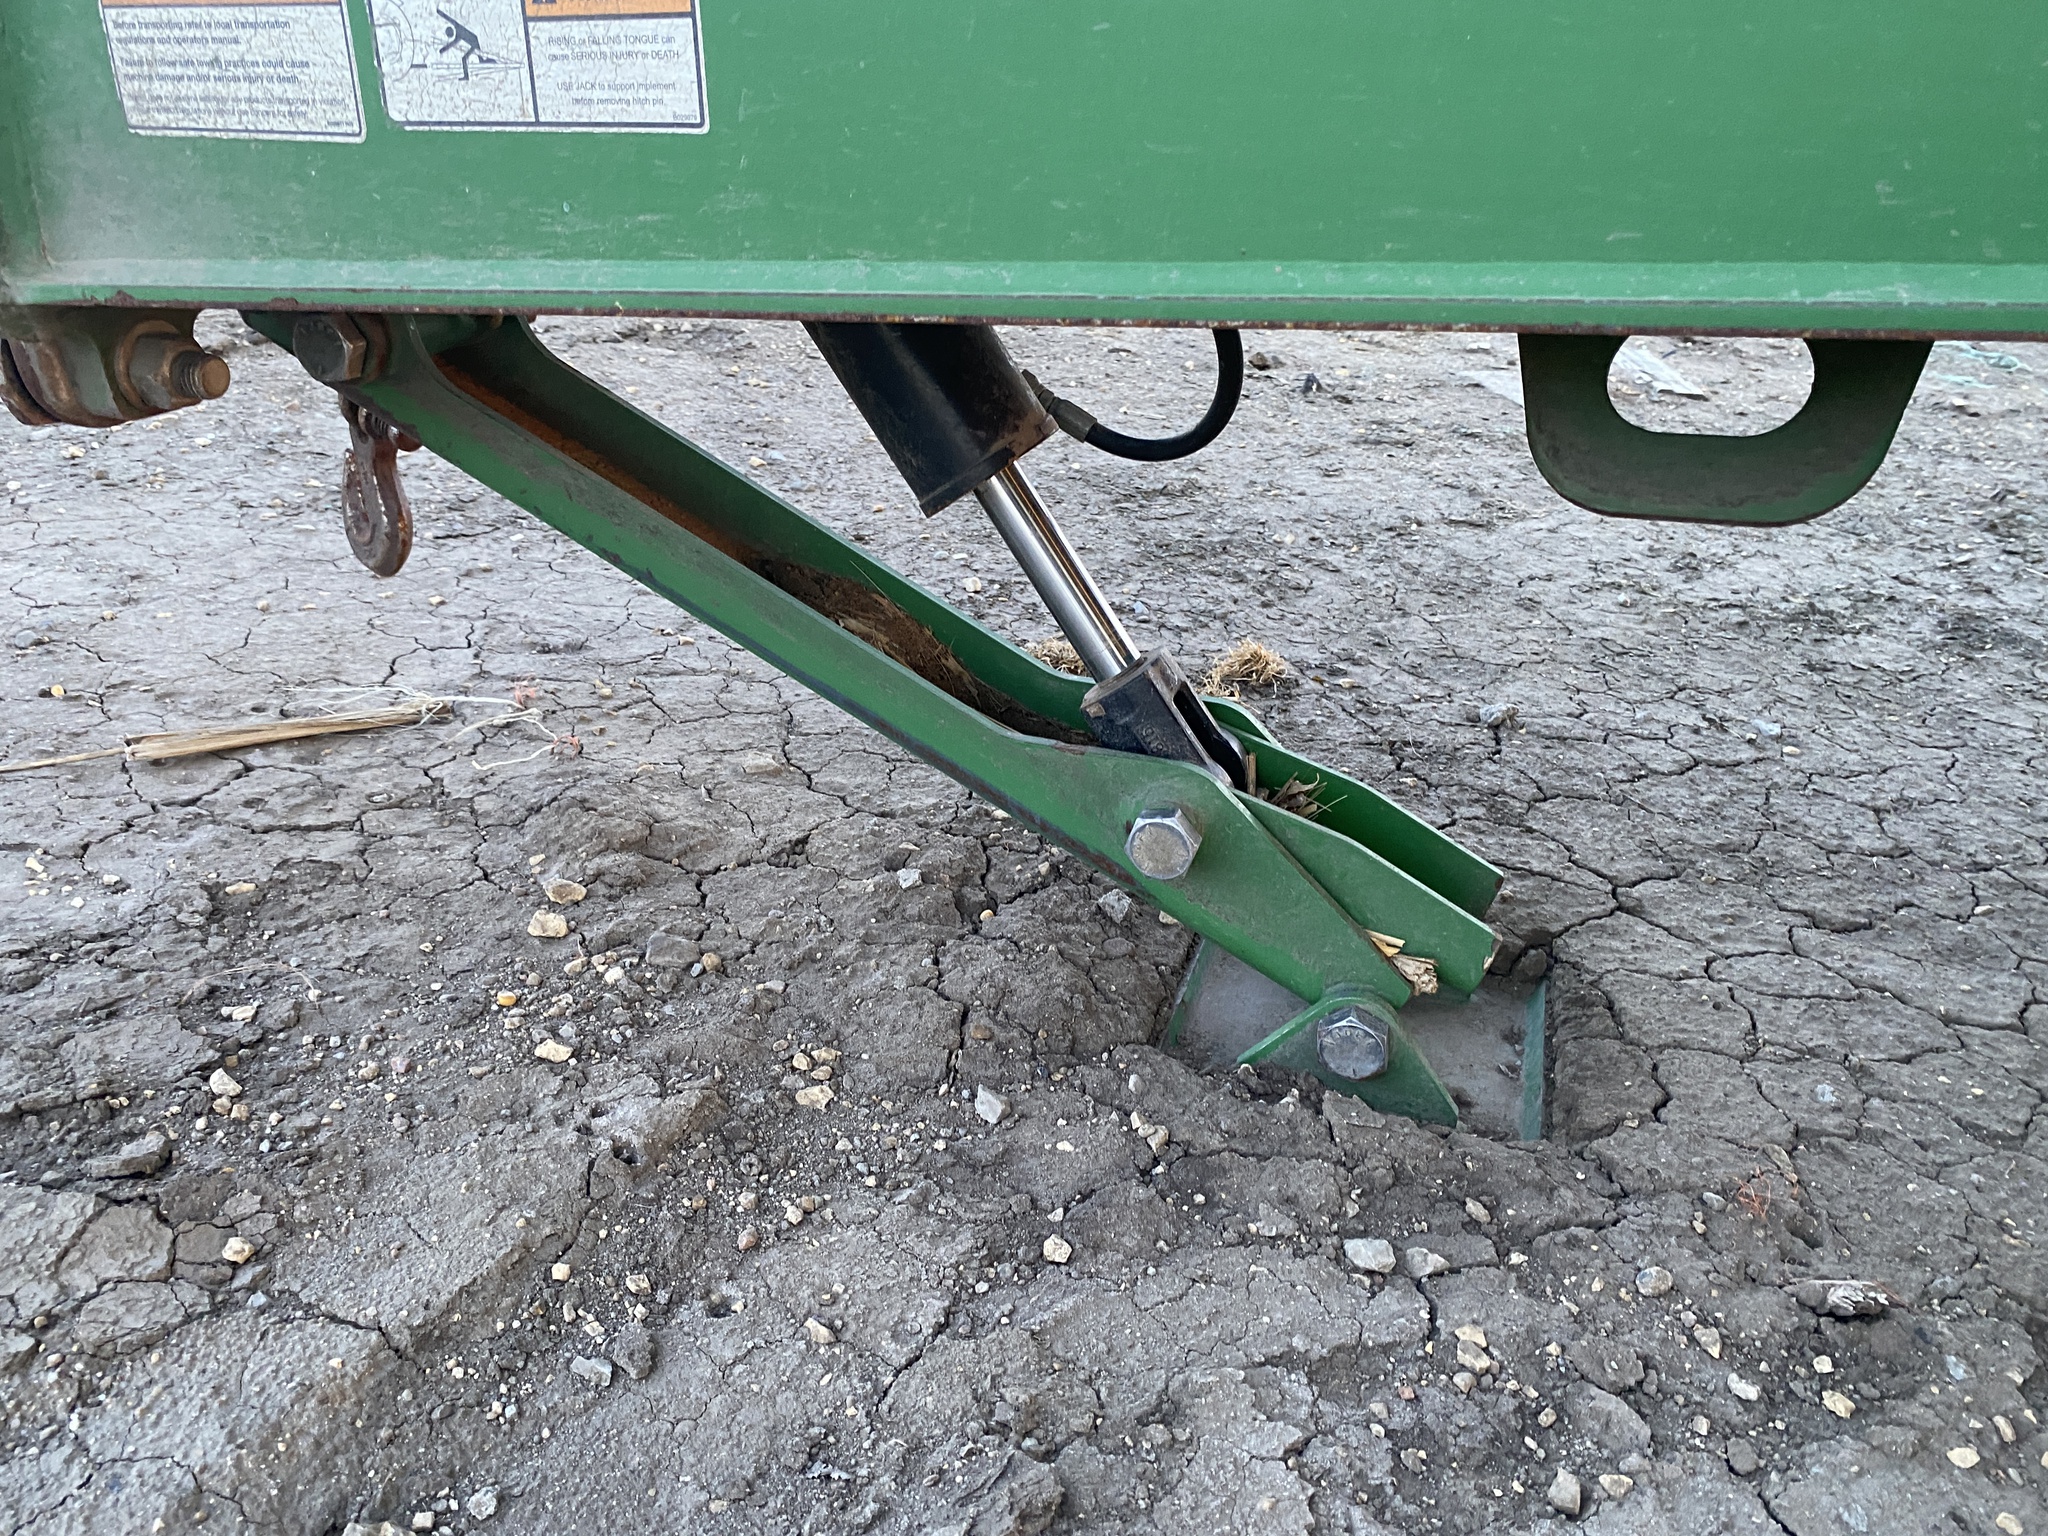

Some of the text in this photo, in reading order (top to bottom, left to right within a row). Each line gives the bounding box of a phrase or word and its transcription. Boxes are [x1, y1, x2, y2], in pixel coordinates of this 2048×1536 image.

[214, 20, 232, 30] local
[234, 20, 290, 30] transportation
[588, 36, 621, 45] FALLING
[624, 34, 659, 44] TONGUE
[662, 36, 676, 44] can
[548, 50, 680, 62] cause SERIOUS INJURY or DEATH
[286, 60, 310, 68] cause
[155, 73, 185, 83] damage
[557, 82, 676, 92] USE JACK to support implement
[596, 97, 630, 107] removing
[632, 96, 650, 106] hitch
